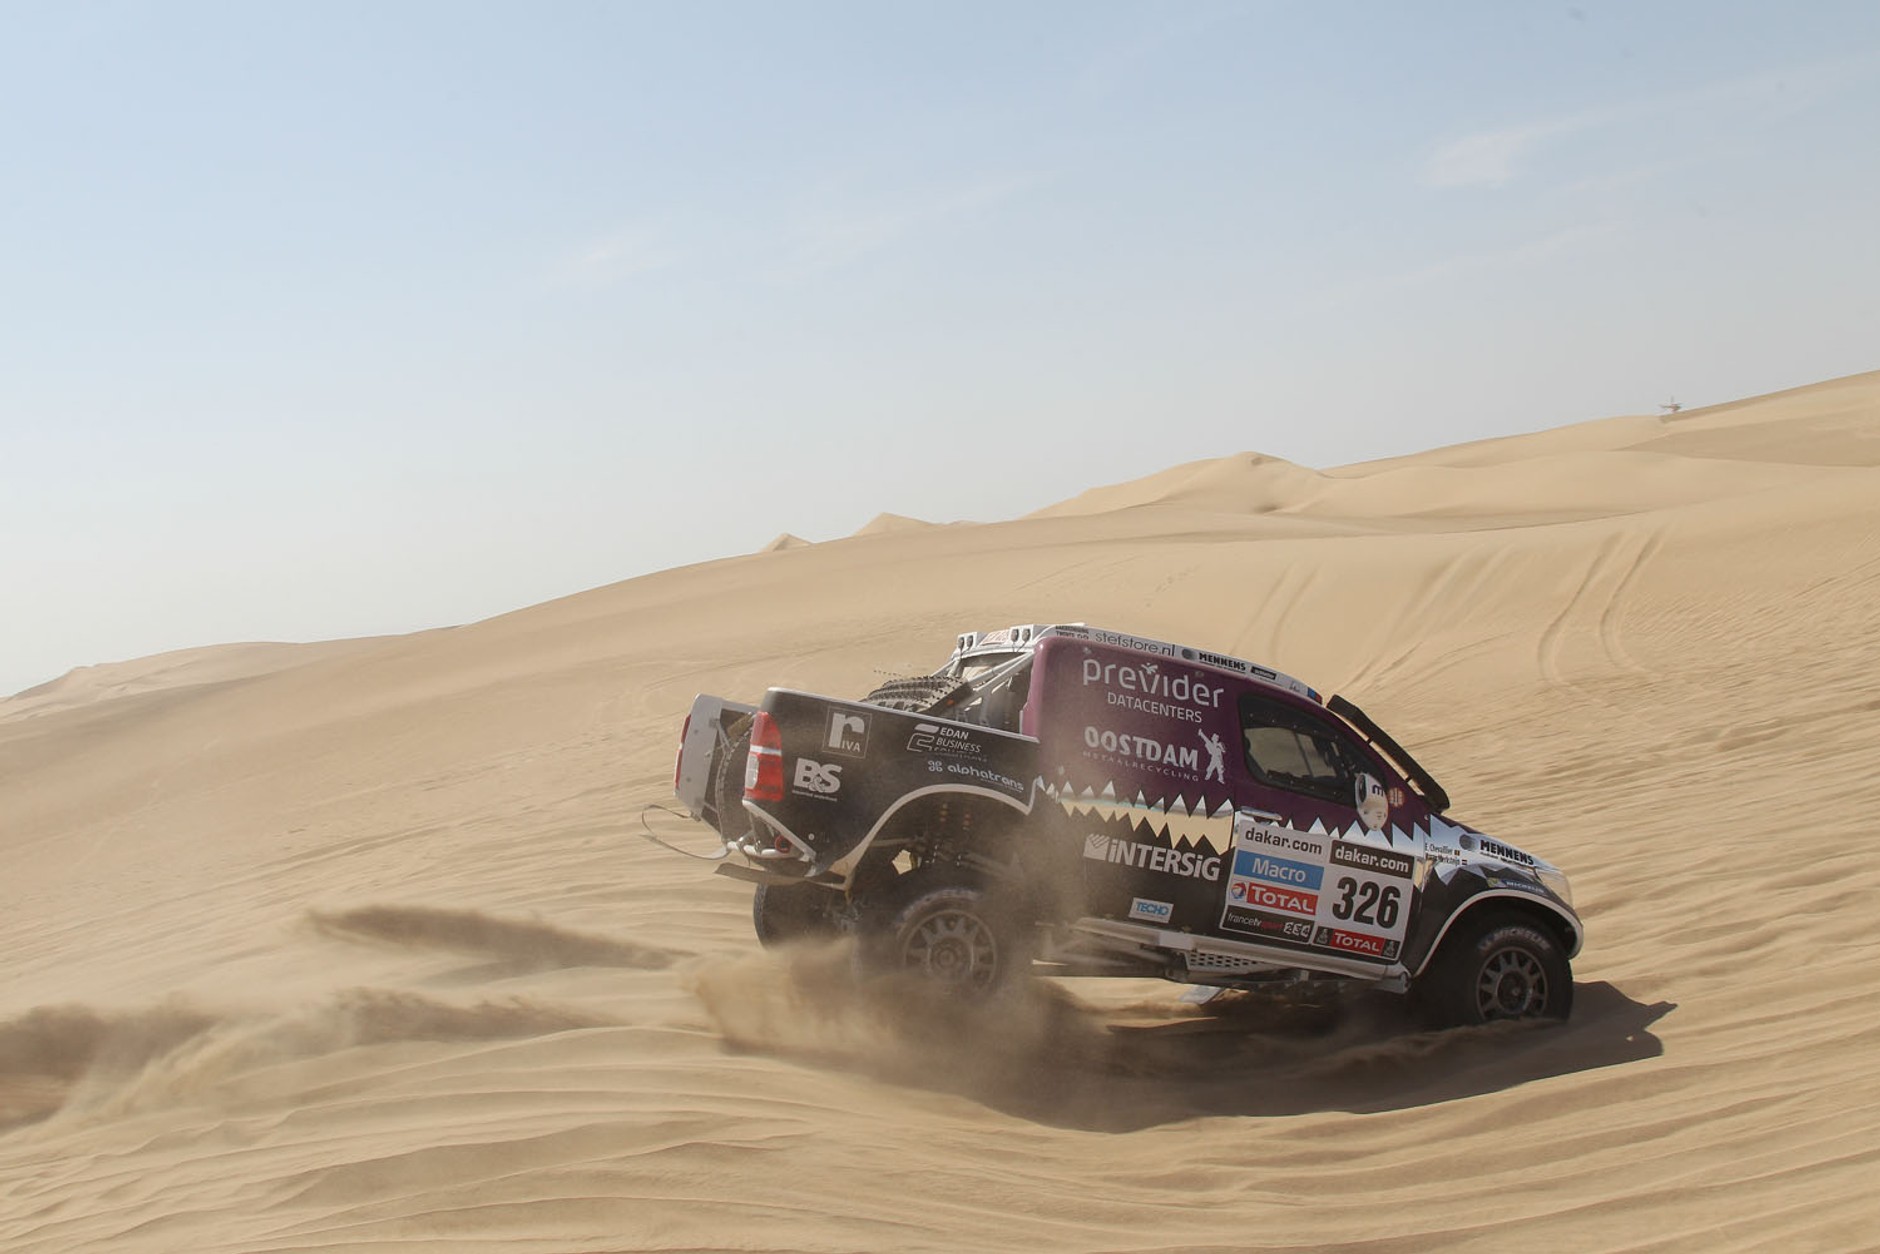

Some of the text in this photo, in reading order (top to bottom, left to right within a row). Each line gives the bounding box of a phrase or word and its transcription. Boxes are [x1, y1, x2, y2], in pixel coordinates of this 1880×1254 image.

[1095, 632, 1175, 657] stefstore.nl
[1199, 652, 1246, 672] MENNENS
[1107, 691, 1203, 724] DATACENTERS
[936, 737, 982, 753] BUSINESS
[940, 727, 969, 740] EDAN
[1084, 726, 1199, 771] OOSTDAM
[793, 757, 843, 793] B&S
[947, 763, 1024, 791] alphatrans
[1245, 827, 1322, 855] dakar.com
[1480, 839, 1535, 865] MENNENS
[1252, 858, 1306, 882] Macro
[1335, 846, 1409, 873] dakar.com
[1251, 885, 1314, 913] TOTAL
[1332, 876, 1402, 929] 326
[1334, 932, 1380, 952] TOTAL
